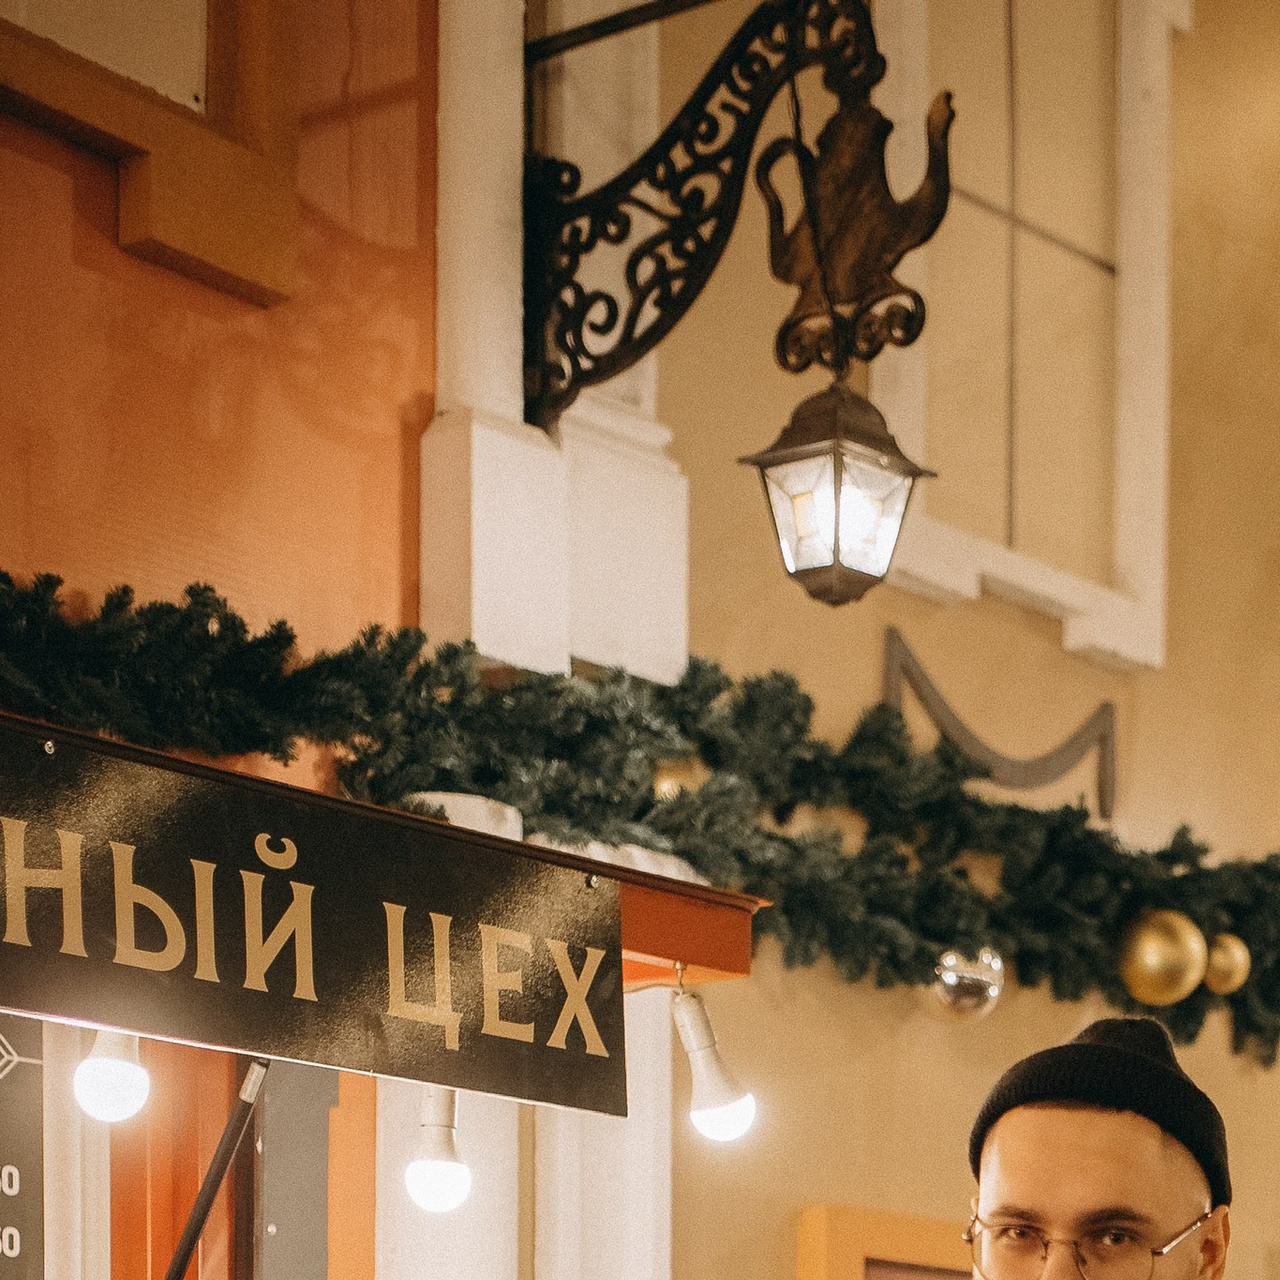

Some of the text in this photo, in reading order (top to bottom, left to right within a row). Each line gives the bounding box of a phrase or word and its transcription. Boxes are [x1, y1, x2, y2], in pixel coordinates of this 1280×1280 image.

[0, 816, 610, 1058] НЫЙ ЦЕХ
[0, 1164, 21, 1197] 0
[0, 1226, 21, 1258] 0
